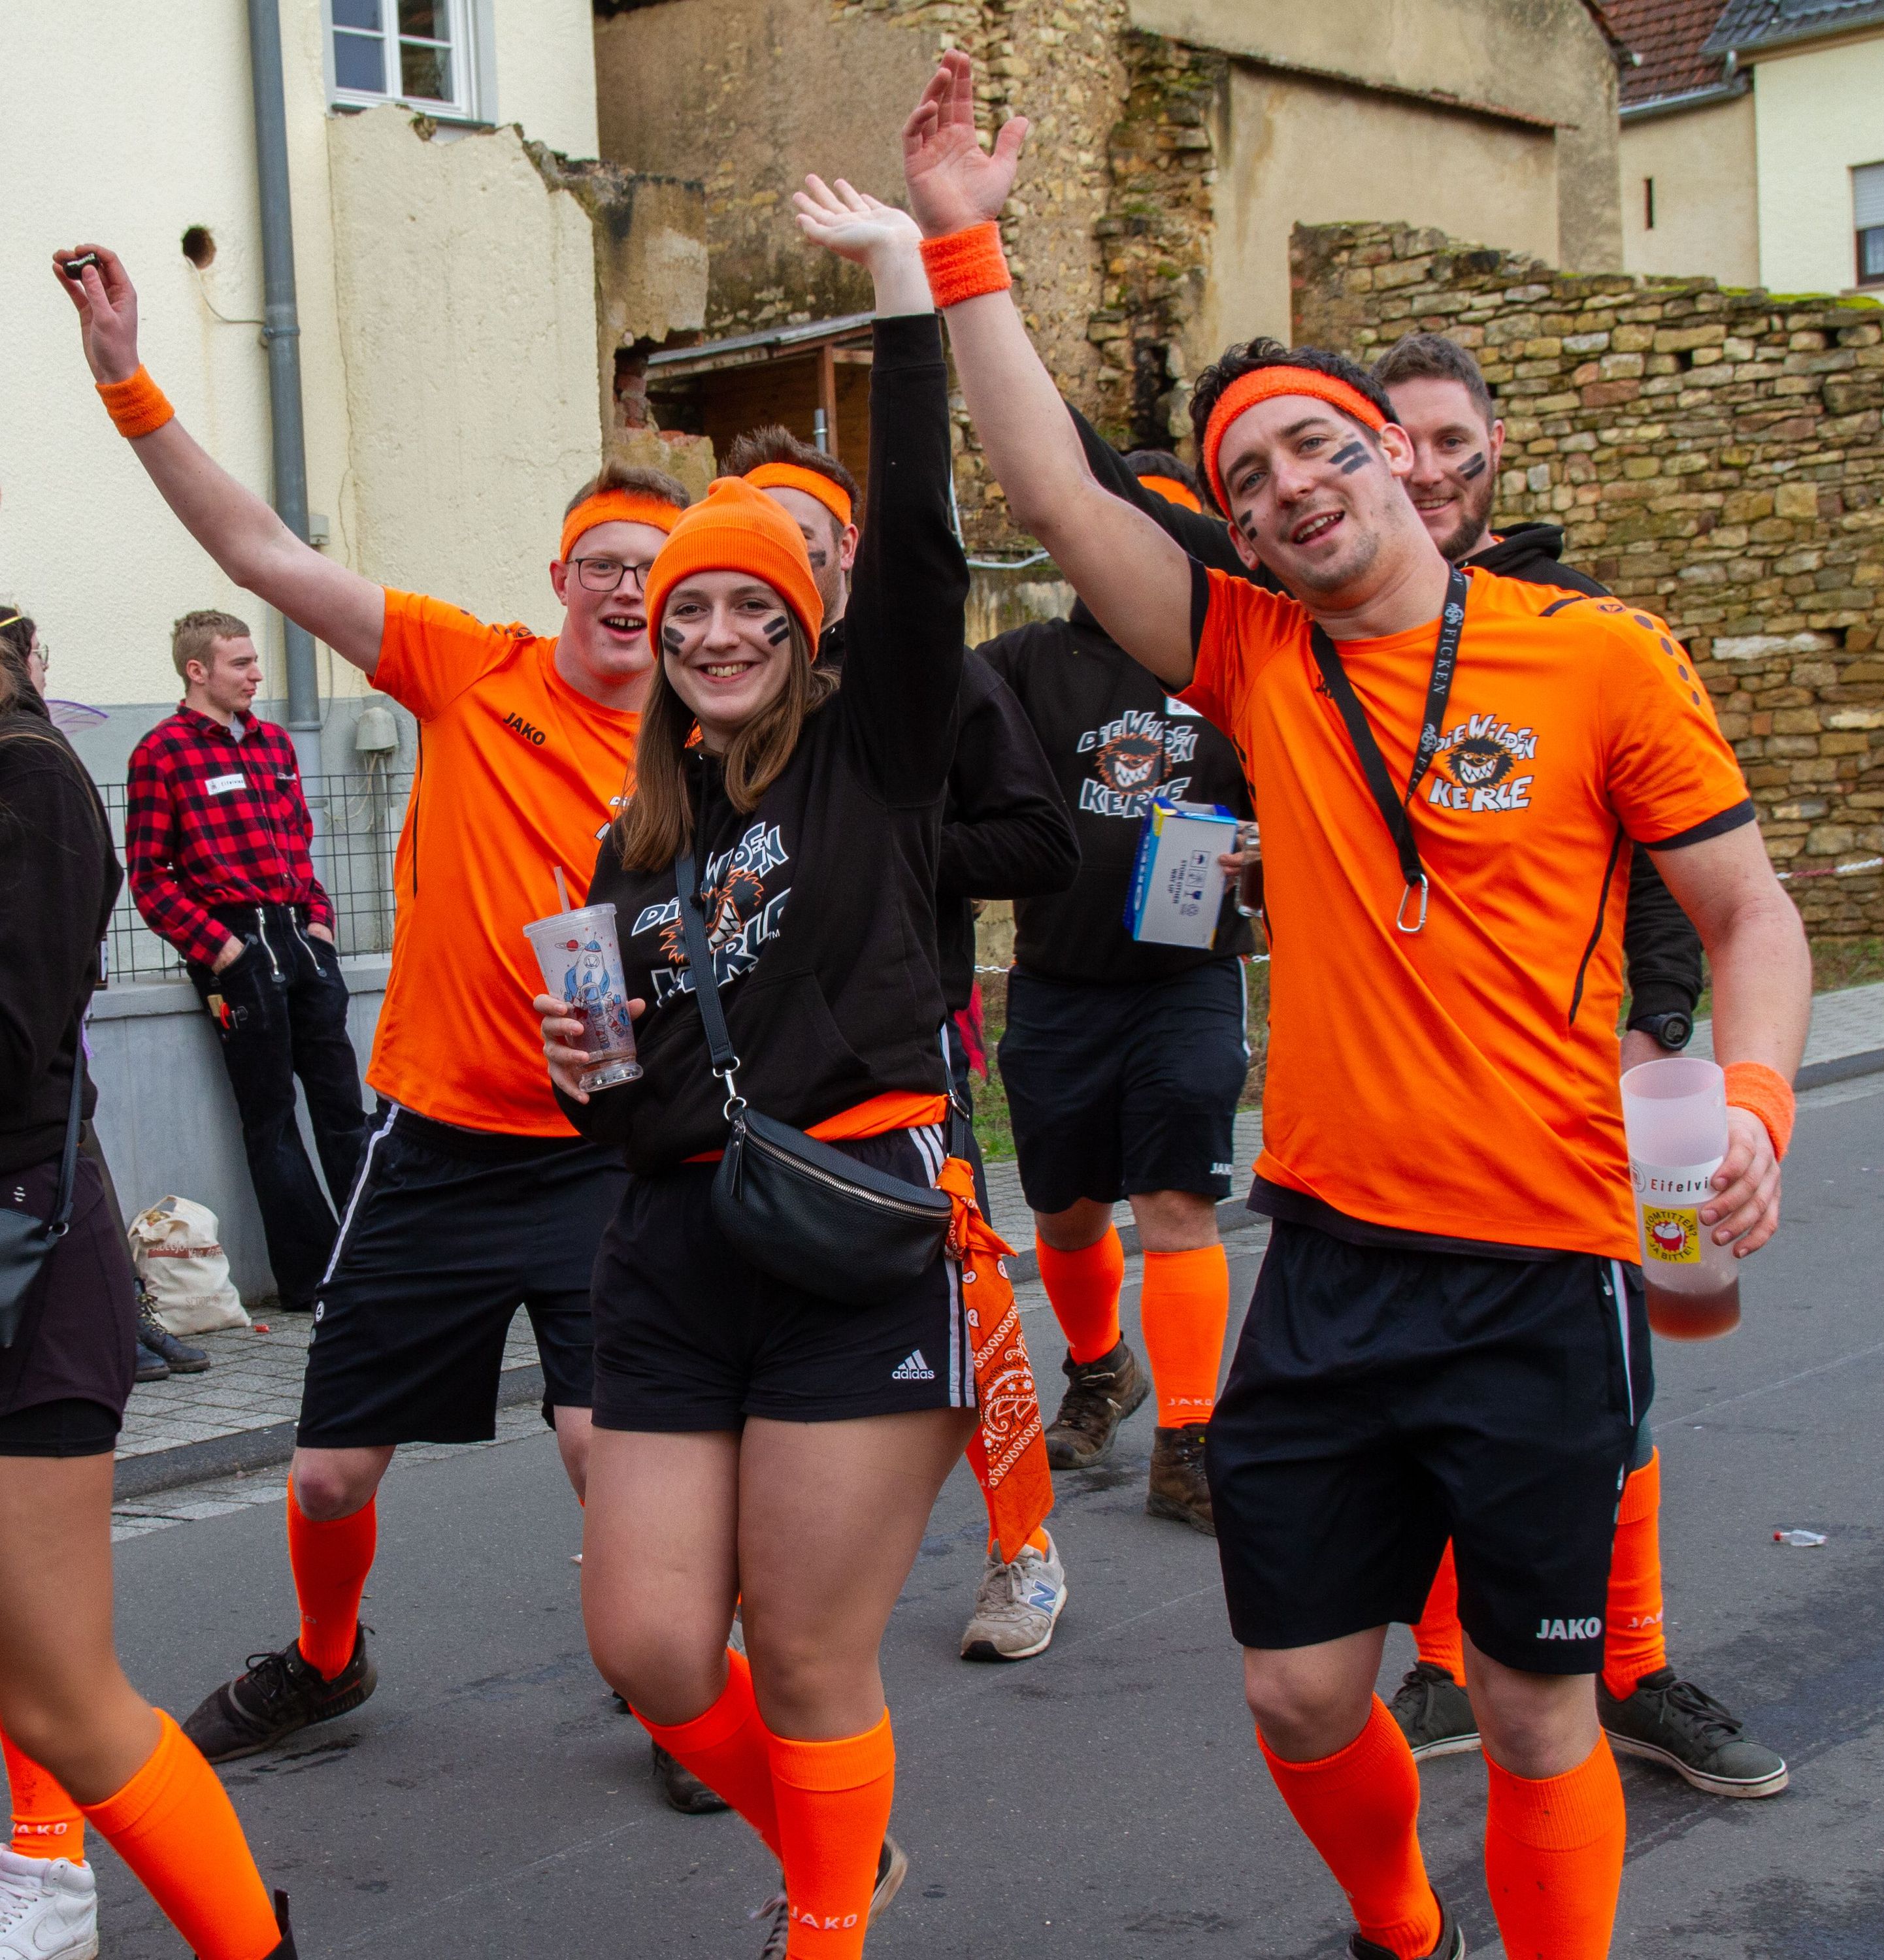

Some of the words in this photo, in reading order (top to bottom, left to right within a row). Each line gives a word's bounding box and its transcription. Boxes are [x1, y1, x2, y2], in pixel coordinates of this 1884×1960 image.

[1433, 628, 1458, 695] FICKEN
[503, 711, 546, 745] JAKO
[1428, 775, 1535, 813] KERLE
[1651, 1177, 1708, 1192] Eifelvi
[891, 1367, 935, 1379] adidas
[1166, 1397, 1214, 1407] JAKO
[1536, 1616, 1602, 1641] JAKO
[790, 1905, 858, 1930] JAKO
